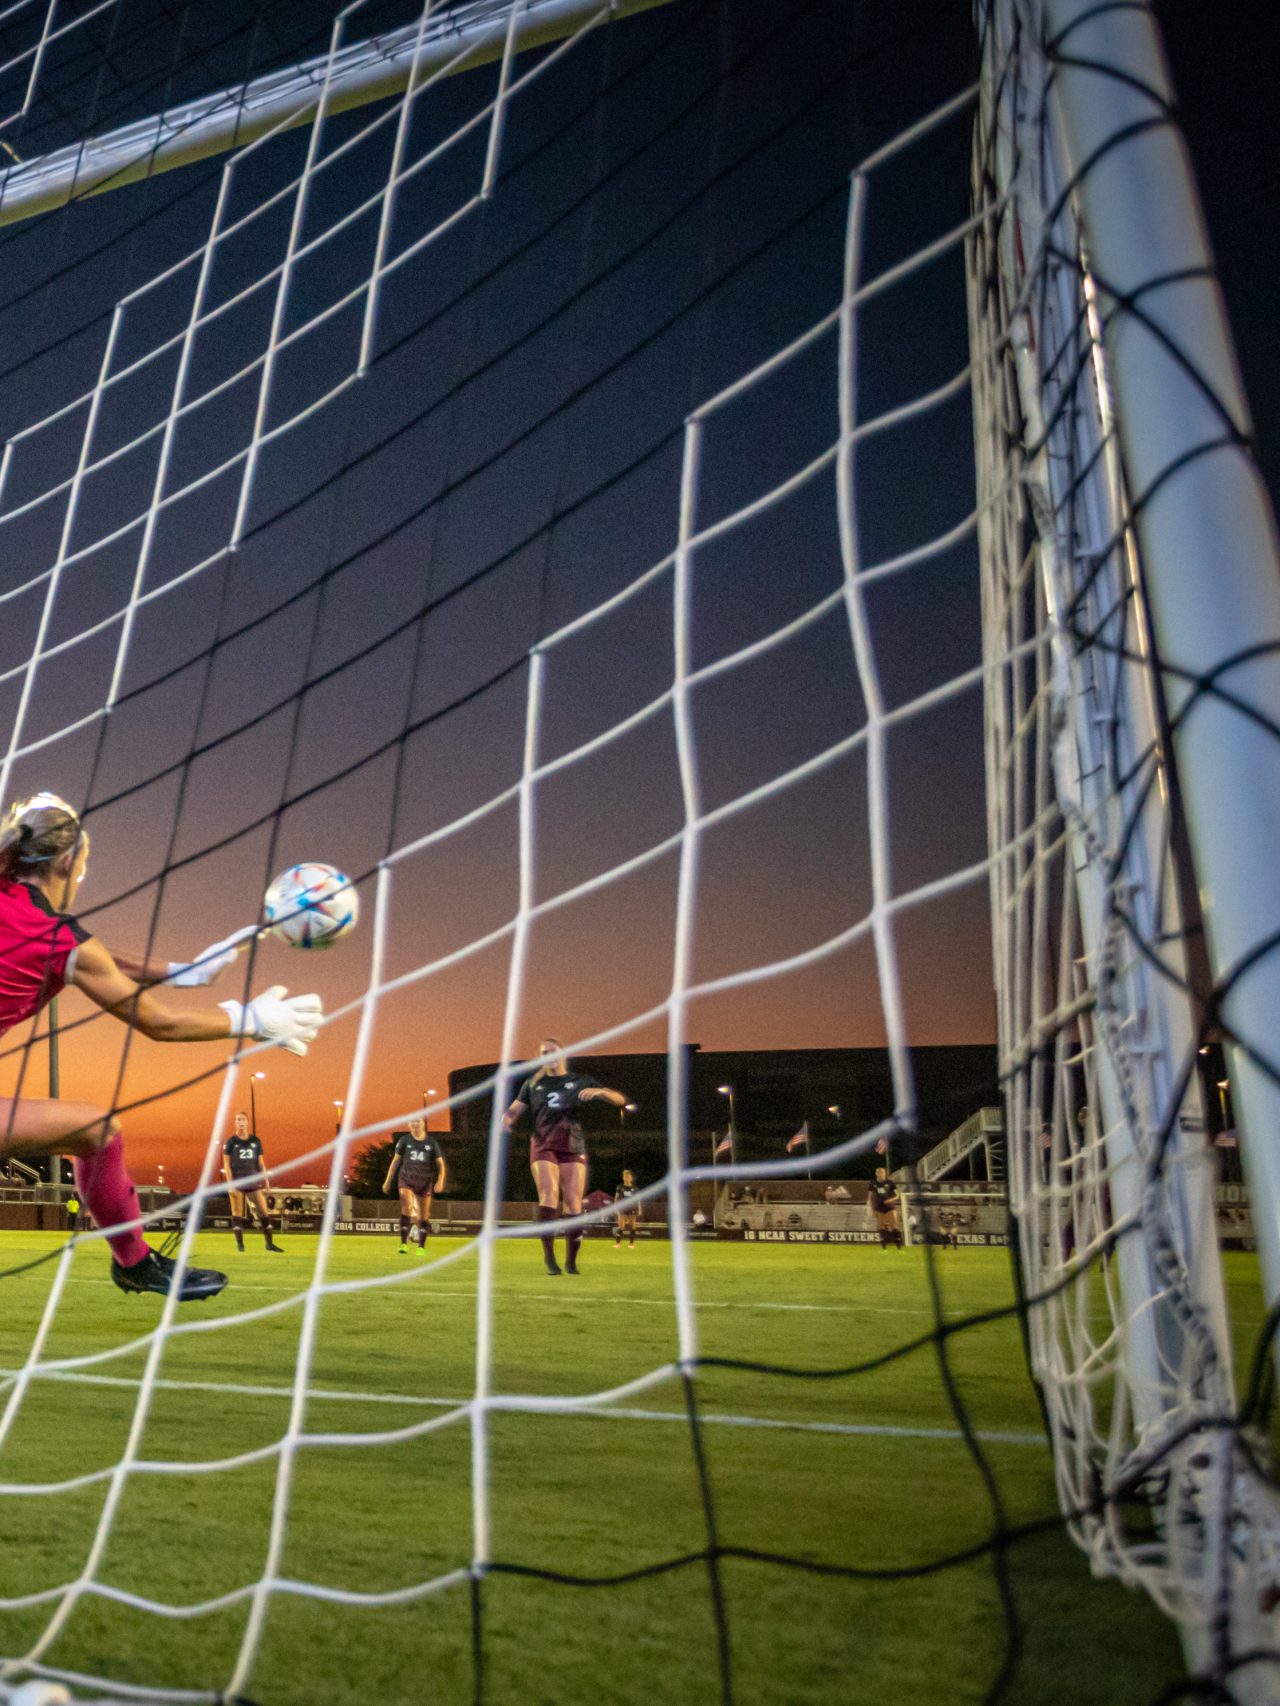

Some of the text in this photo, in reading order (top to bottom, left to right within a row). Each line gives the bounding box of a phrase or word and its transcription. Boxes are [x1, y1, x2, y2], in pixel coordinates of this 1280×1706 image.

[547, 1092, 560, 1108] 2
[239, 1148, 254, 1159] 23
[410, 1150, 424, 1161] 34
[334, 1222, 353, 1231] 2014
[355, 1222, 391, 1232] COLLEGE
[759, 1231, 785, 1240] NCAA
[789, 1231, 825, 1241] SWEET
[828, 1232, 881, 1242] SIXTEENS
